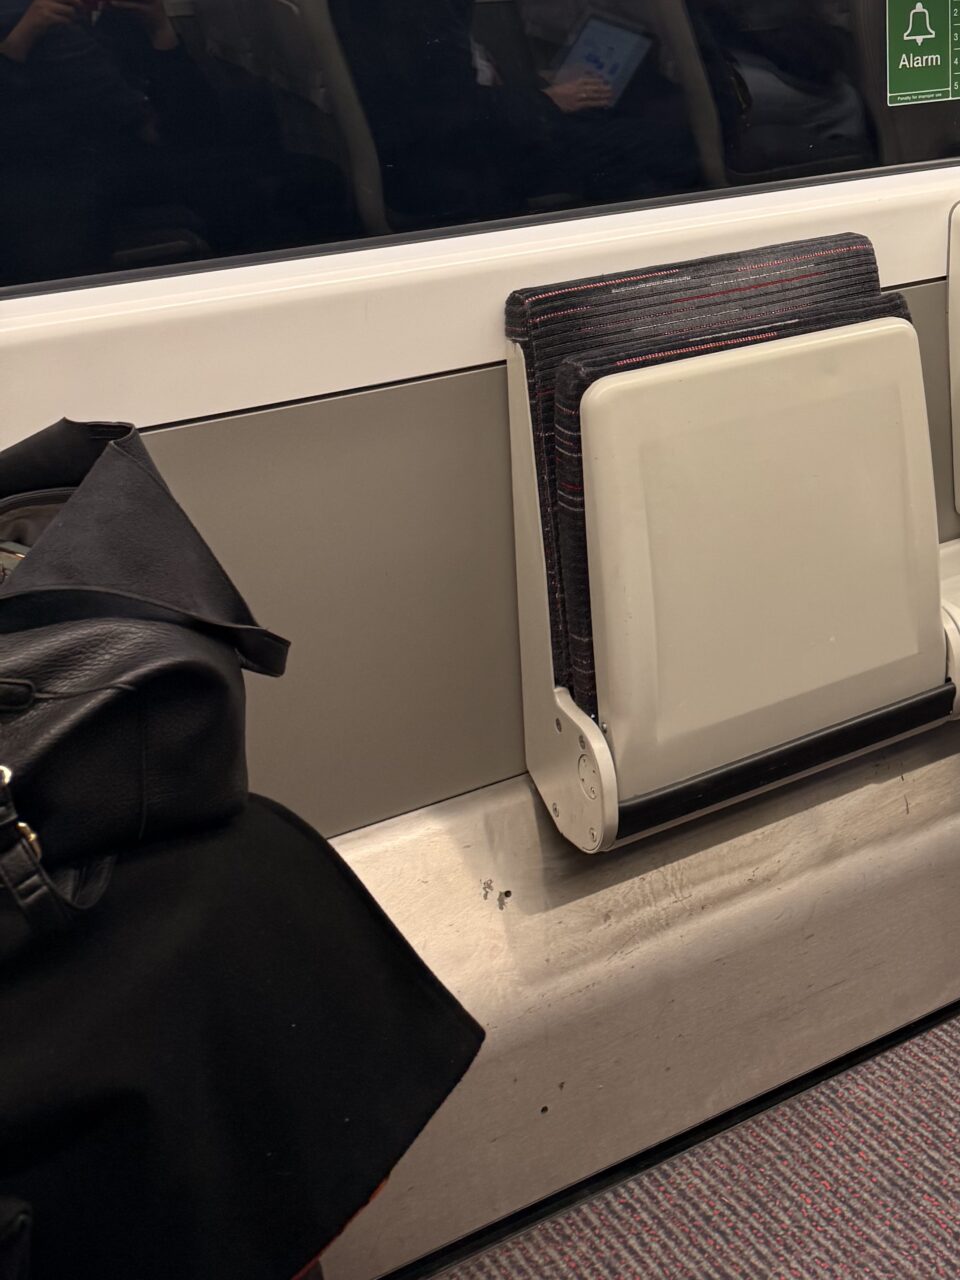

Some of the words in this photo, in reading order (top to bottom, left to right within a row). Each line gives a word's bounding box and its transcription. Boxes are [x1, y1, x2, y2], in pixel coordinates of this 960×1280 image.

[953, 8, 958, 16] 2
[954, 32, 958, 40] 3
[899, 53, 941, 69] Alarm
[954, 57, 958, 65] 4
[954, 81, 958, 89] 5
